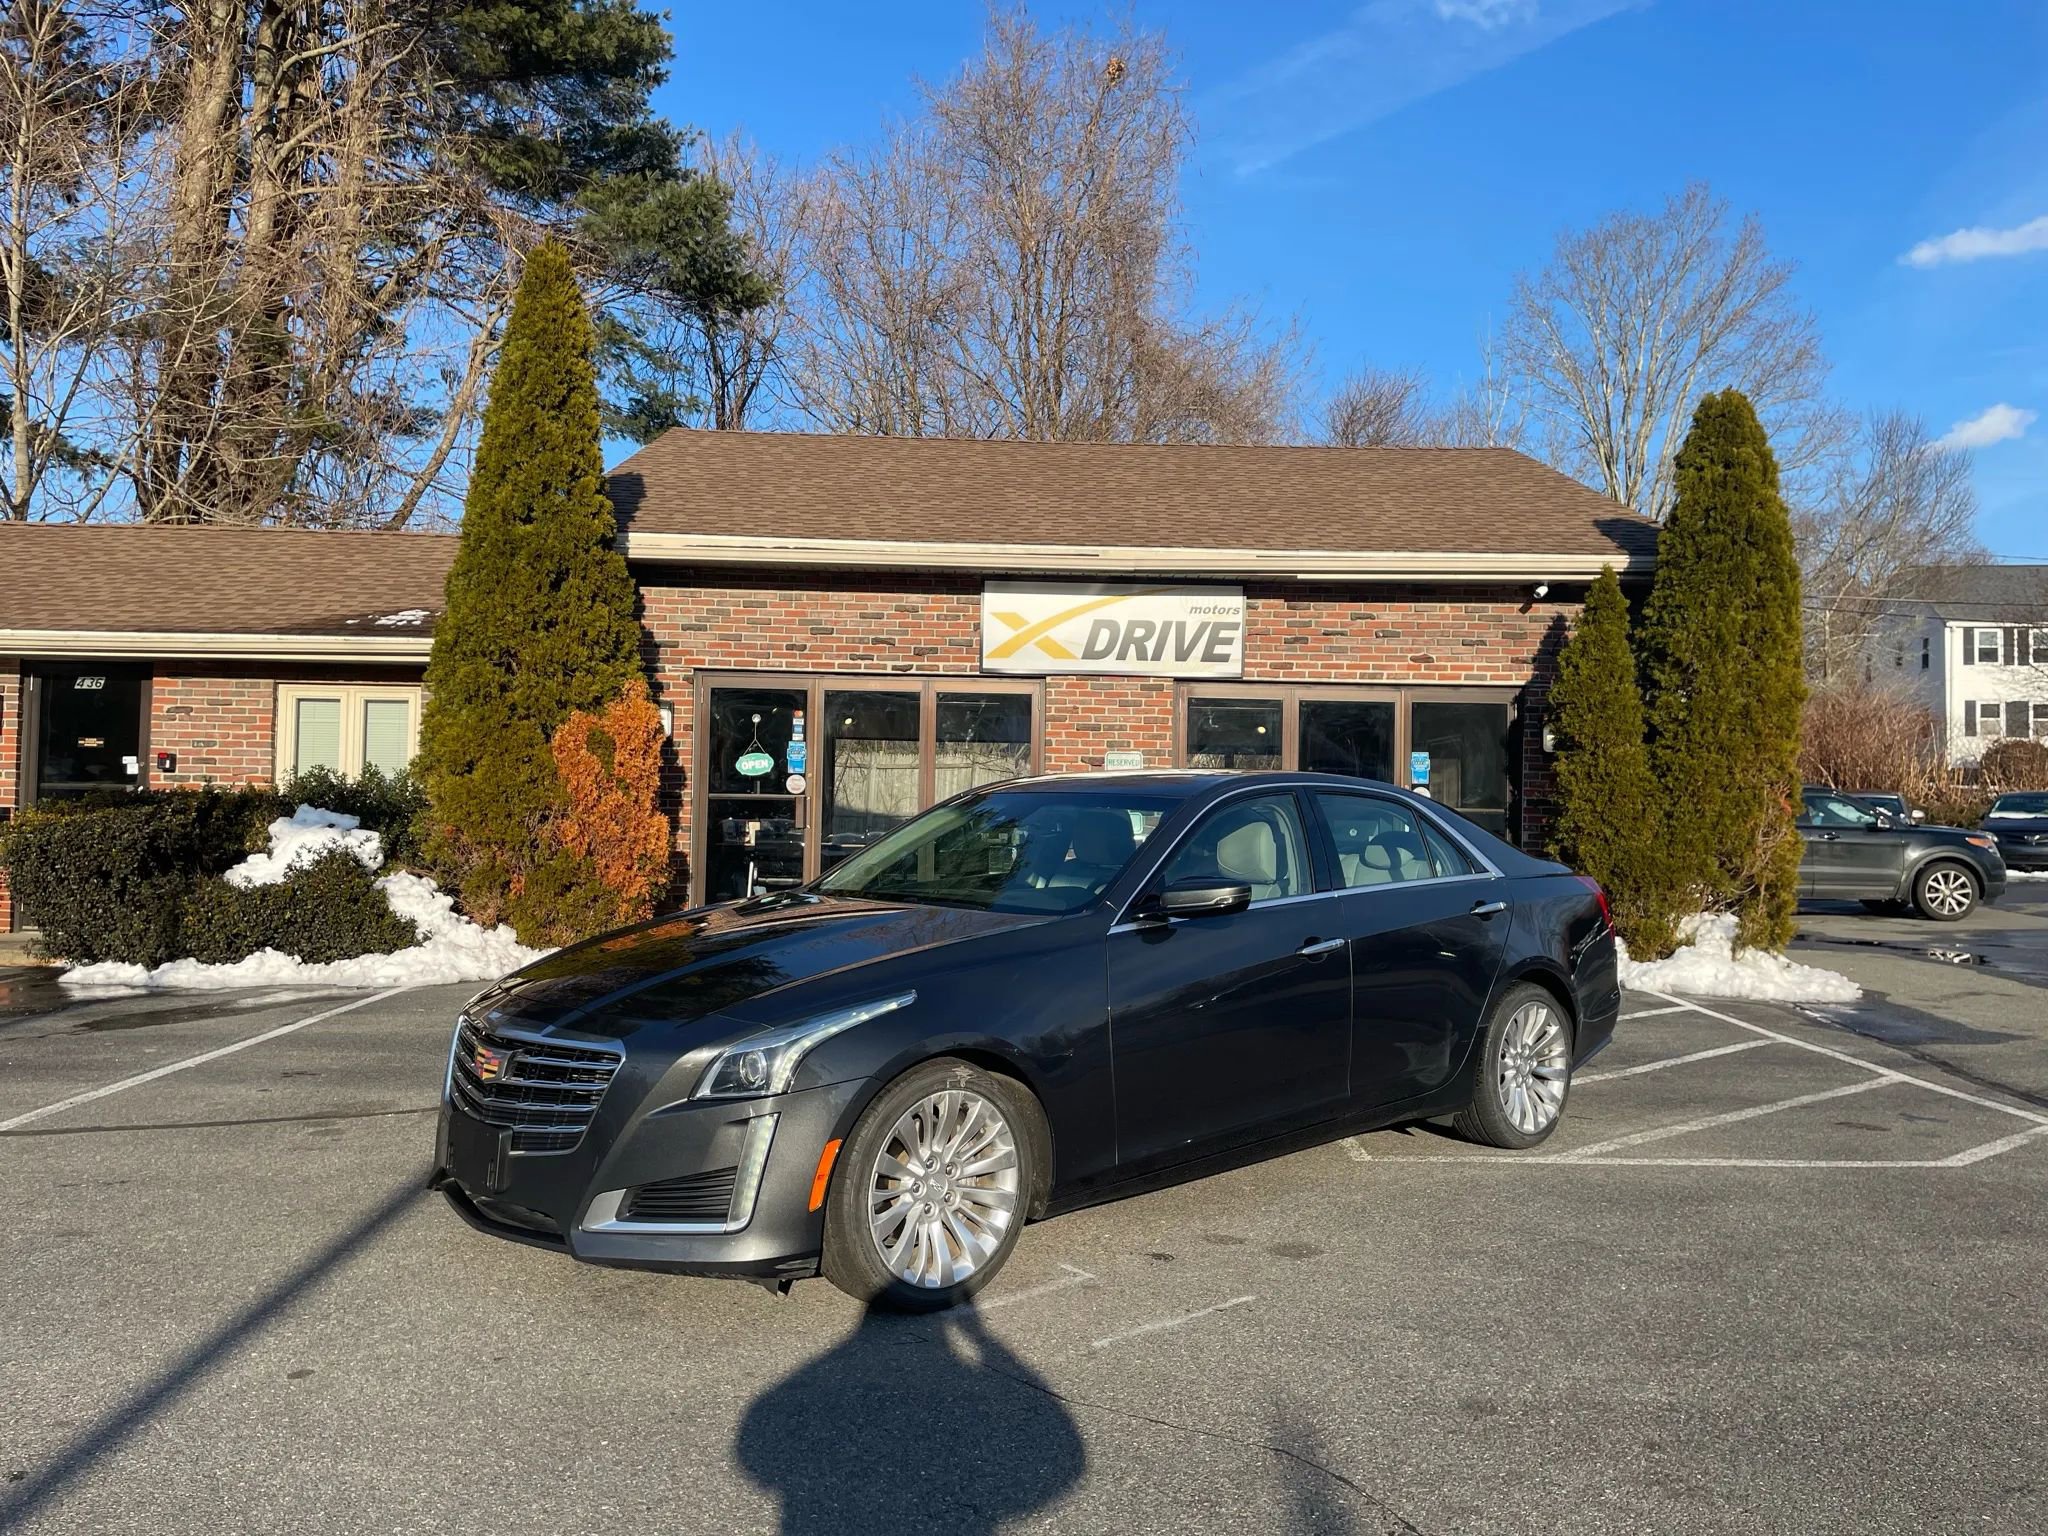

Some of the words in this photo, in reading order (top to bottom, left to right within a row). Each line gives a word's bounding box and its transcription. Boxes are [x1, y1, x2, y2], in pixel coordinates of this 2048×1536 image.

[1189, 605, 1241, 615] motors
[76, 677, 103, 688] 436
[741, 759, 769, 771] OPEN
[1108, 759, 1140, 767] RESERVED
